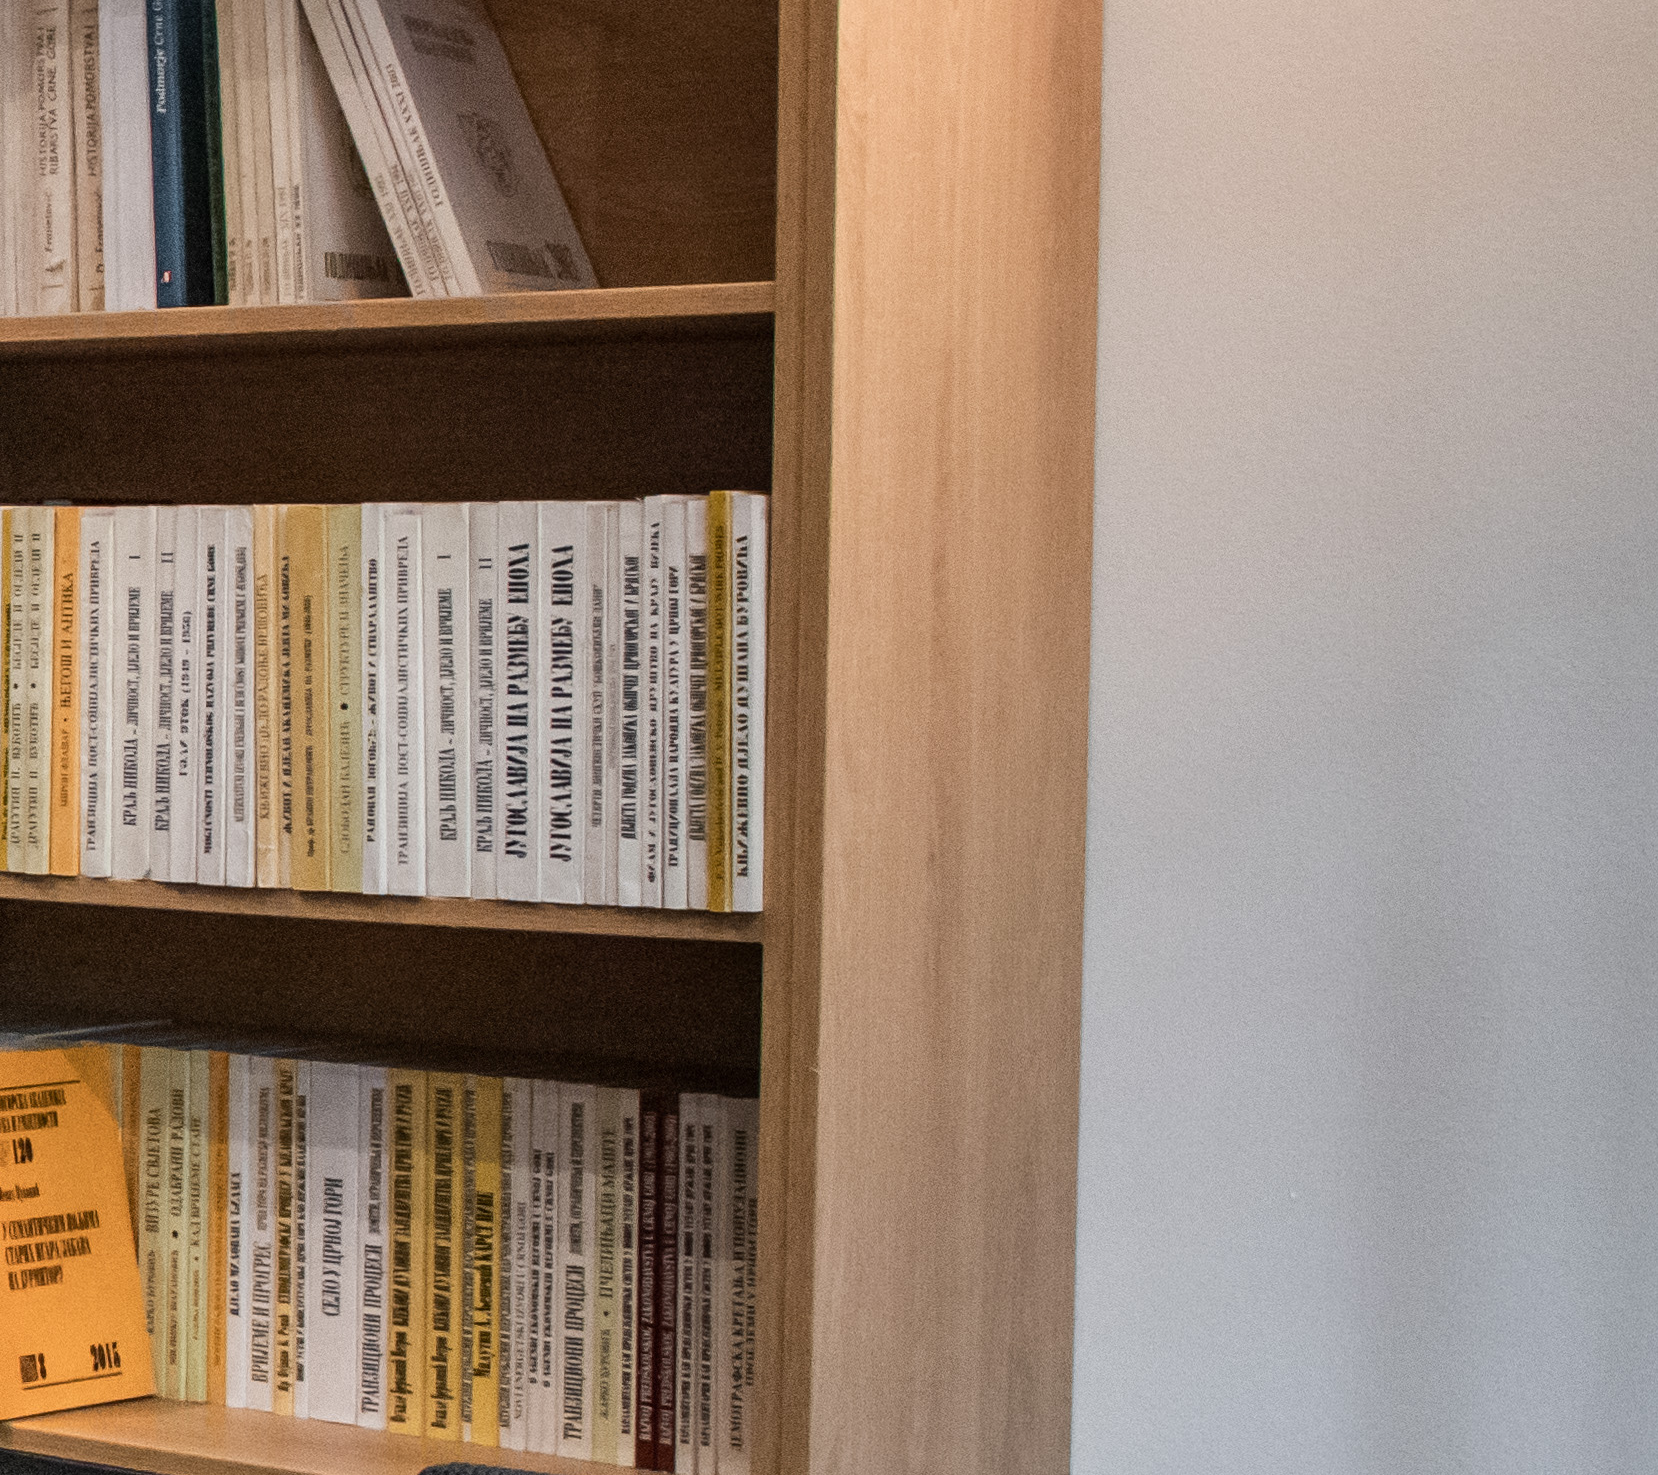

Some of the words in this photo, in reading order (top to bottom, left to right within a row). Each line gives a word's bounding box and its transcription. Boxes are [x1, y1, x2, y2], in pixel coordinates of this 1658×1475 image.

[44, 25, 56, 60] GORE
[153, 15, 164, 46] Crne
[45, 68, 57, 102] CRNE
[154, 48, 168, 114] Podmorje
[396, 536, 410, 605] ПРИВРЕДА
[506, 542, 531, 606] ЕПОХА
[550, 544, 575, 608] ЕПОХА
[60, 571, 75, 635] АНТИКА
[59, 654, 73, 709] ЊЕГОШ
[179, 698, 191, 736] ОТОК
[505, 701, 530, 728] НА
[549, 704, 574, 732] НА
[122, 739, 138, 789] НИКОЛА
[154, 743, 172, 794] НИКОЛА
[437, 747, 458, 802] НИКОЛА
[475, 758, 494, 813] НИКОЛА
[122, 792, 138, 827] КРАЉ
[154, 797, 171, 832] КРАЉ
[396, 781, 410, 867] ТРАНЗИЦИЈА
[437, 805, 458, 842] КРАЉ
[504, 733, 530, 860] ЈУГОСЛАВИЈА
[548, 736, 574, 864] ЈУГОСЛАВИЈА
[475, 816, 495, 854] КРАЉ
[170, 1087, 185, 1141] РАДОВИ
[145, 1107, 162, 1180] СВЈЕТОВА
[601, 1129, 617, 1190] МАШТЕ
[322, 1176, 344, 1217] ГОРИ
[321, 1217, 346, 1267] ЦРНОЈ
[598, 1194, 617, 1300] ПЧЕЛИЊАЦИ
[252, 1241, 272, 1305] ПРОГРЕС
[320, 1278, 343, 1317] СЕЛО
[362, 1243, 385, 1310] ПРОЦЕСИ
[563, 1264, 587, 1332] ПРОЦЕСИ
[730, 1265, 747, 1337] КРЕТАЊА
[250, 1317, 271, 1384] ВРИЈЕМЕ
[360, 1313, 383, 1414] ТРАНЗИЦИОНИ
[562, 1335, 586, 1442] ТРАНЗИЦИОНИ
[729, 1340, 746, 1452] ДЕМОГРАФСКА
